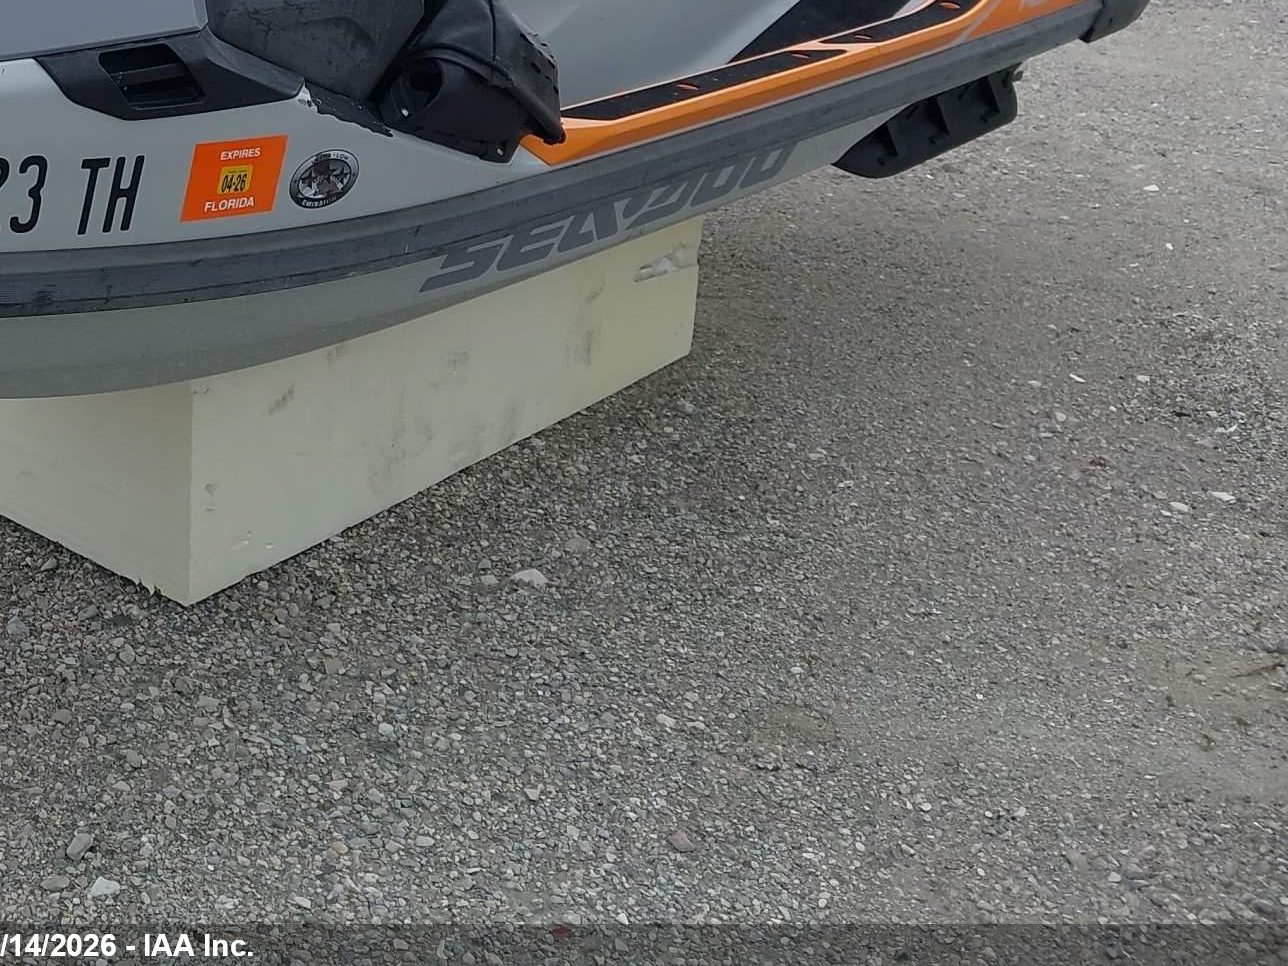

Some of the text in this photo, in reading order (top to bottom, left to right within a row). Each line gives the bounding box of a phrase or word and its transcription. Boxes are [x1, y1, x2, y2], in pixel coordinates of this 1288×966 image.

[220, 147, 261, 161] EXPIRES
[221, 173, 248, 193] 04-26
[78, 155, 146, 235] TH
[204, 196, 255, 213] FLORIDA
